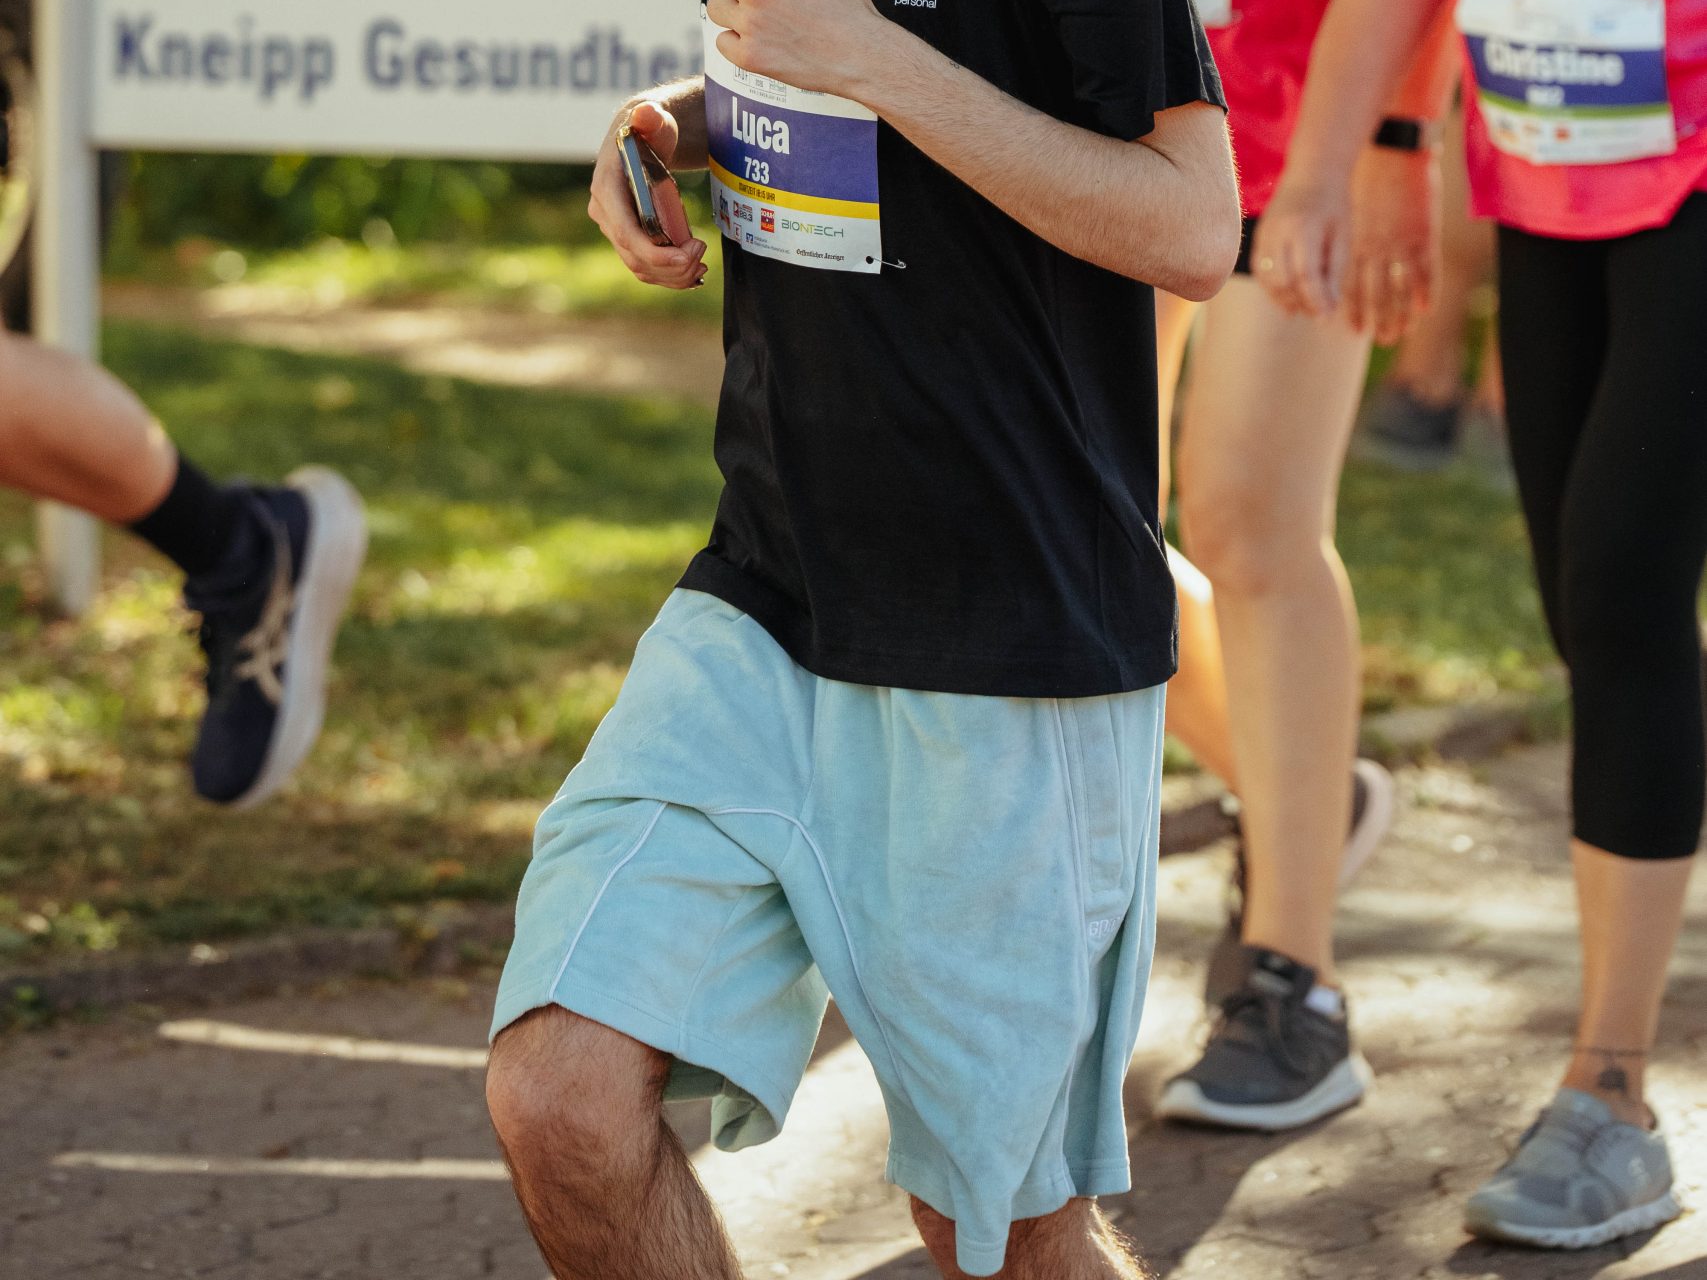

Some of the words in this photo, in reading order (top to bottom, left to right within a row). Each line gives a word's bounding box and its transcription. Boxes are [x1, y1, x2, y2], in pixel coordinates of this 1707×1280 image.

[112, 14, 337, 101] Kneipp
[732, 95, 790, 155] Luca
[744, 155, 770, 185] 733
[781, 218, 844, 238] BIONTECH
